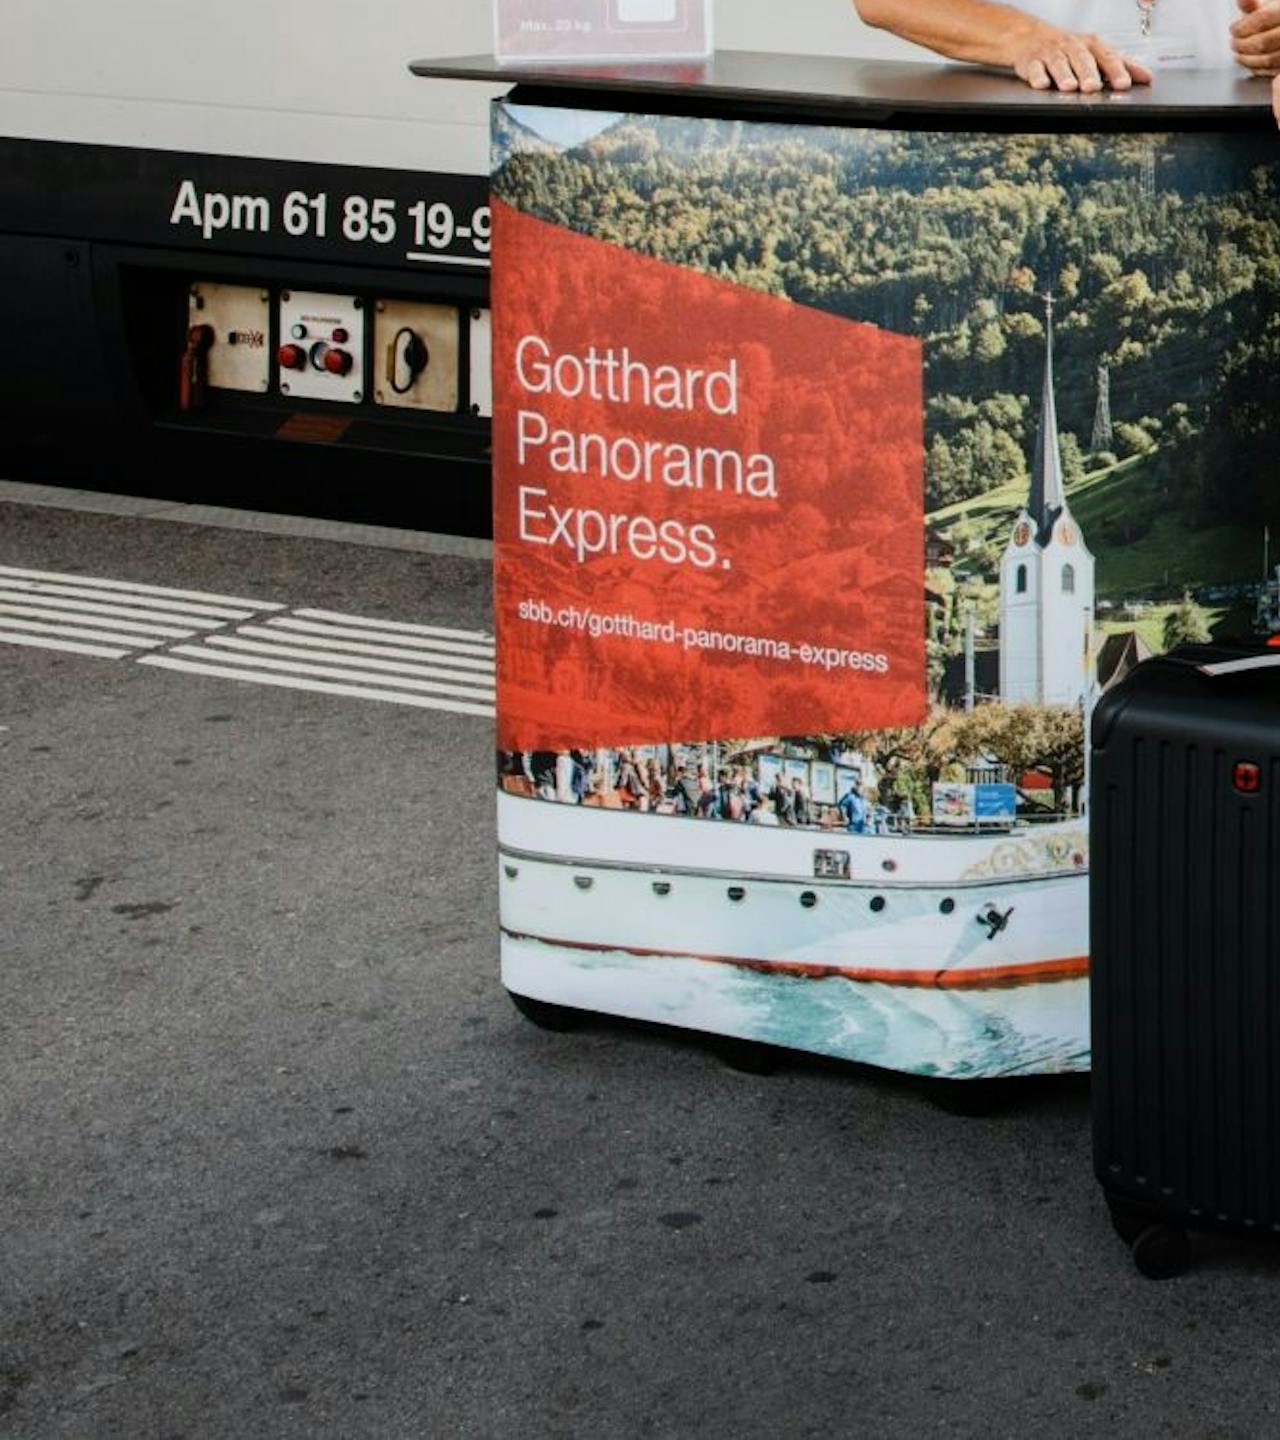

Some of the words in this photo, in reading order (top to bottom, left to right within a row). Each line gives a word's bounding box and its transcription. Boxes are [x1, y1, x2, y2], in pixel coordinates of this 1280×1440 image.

[170, 180, 270, 240] Apm
[282, 190, 327, 237] 61
[342, 194, 397, 243] 85
[515, 335, 738, 415] Gotthard
[516, 409, 778, 498] Panorama
[518, 486, 731, 570] Express.
[518, 598, 889, 673] sbb.ch/gotthard-panorama-express
